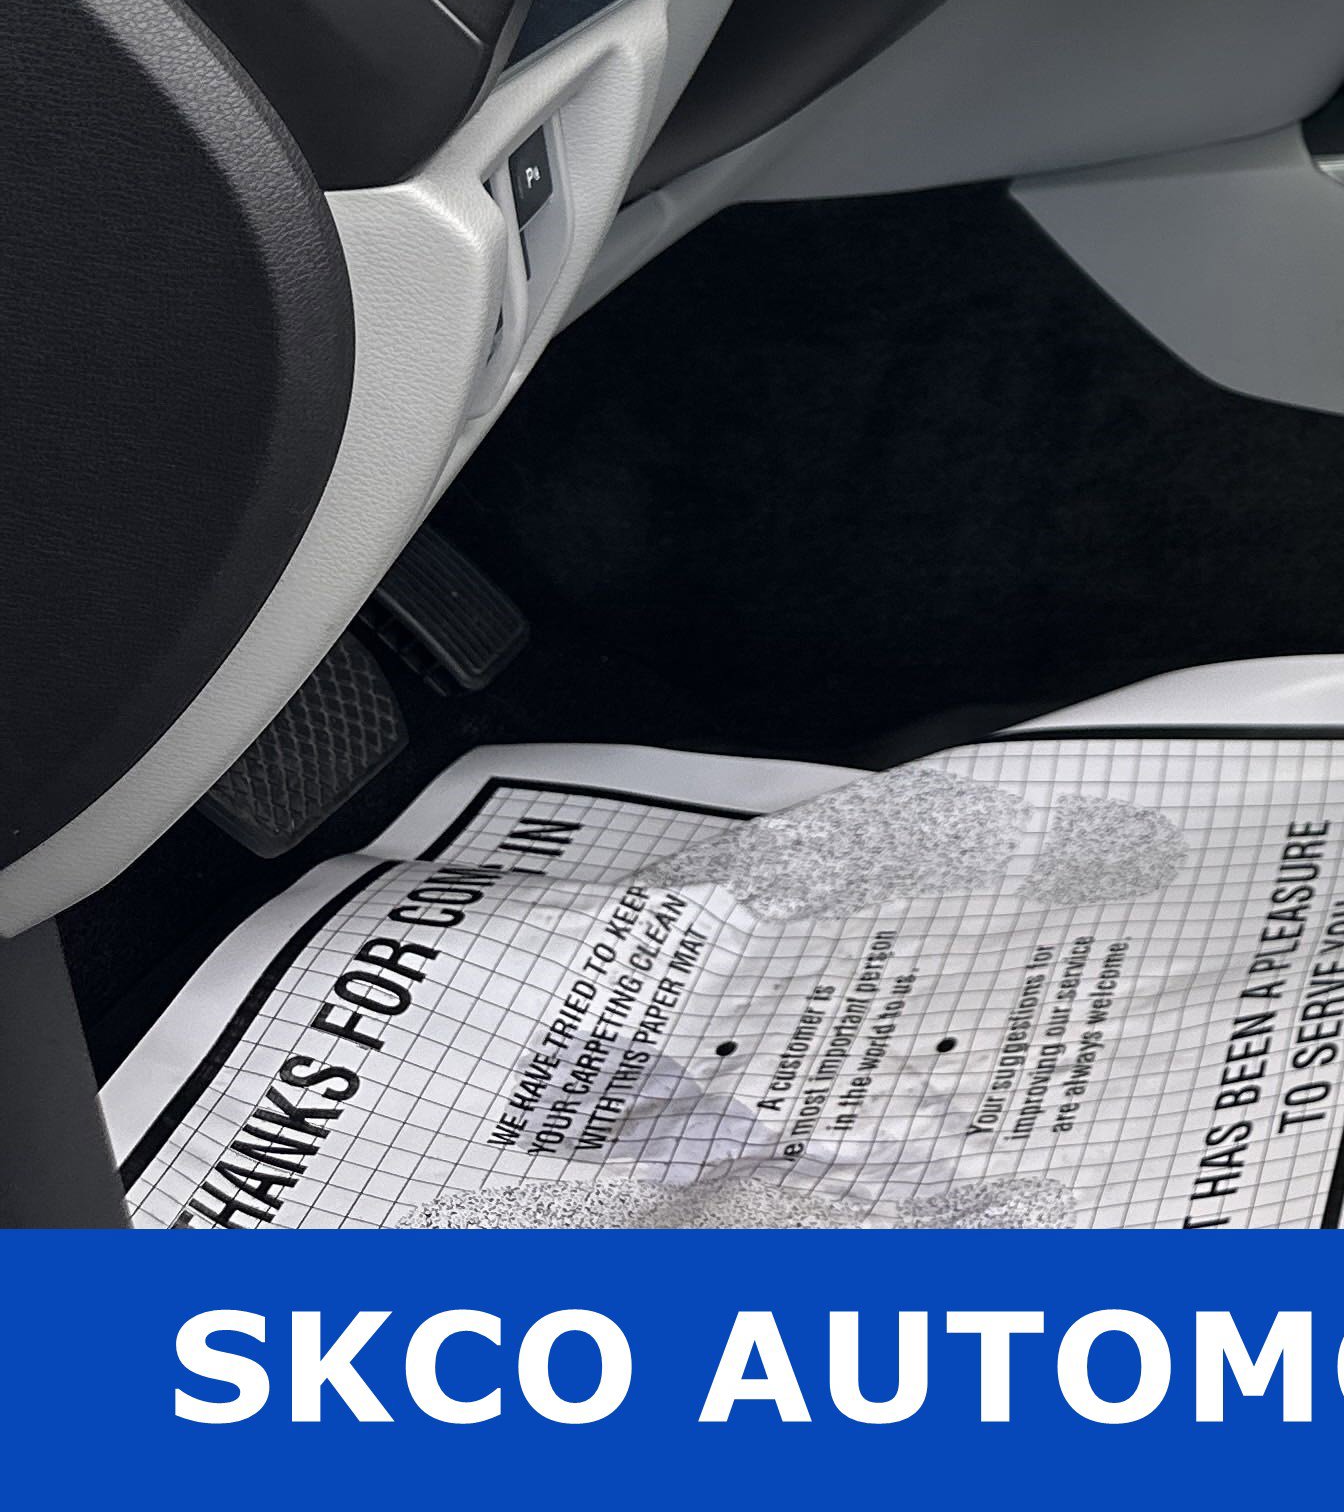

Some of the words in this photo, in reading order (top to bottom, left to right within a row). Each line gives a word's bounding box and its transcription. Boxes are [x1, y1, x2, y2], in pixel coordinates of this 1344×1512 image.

[1248, 819, 1331, 974] PLEASURE
[805, 984, 836, 1002] is
[856, 930, 898, 994] person
[1057, 935, 1096, 1000] service
[1240, 979, 1286, 999] A
[172, 1055, 360, 1229] HANKS
[310, 937, 442, 1051] FOR
[498, 817, 583, 856] IN
[487, 1112, 527, 1147] WE
[509, 1051, 561, 1112] HAVE
[542, 980, 597, 1049] TRIED
[583, 942, 616, 975] TO
[605, 885, 649, 940] KEEP
[528, 1098, 580, 1155] YOUR
[563, 974, 644, 1095] CARPETING
[630, 893, 687, 972] CLEAN
[575, 1096, 626, 1151] WITH
[606, 1049, 650, 1097] THIS
[632, 976, 685, 1045] PAPER
[668, 923, 708, 973] MAT
[808, 997, 870, 1083] important
[879, 999, 905, 1020] to
[966, 1096, 1007, 1137] Your
[992, 974, 1046, 1091] suggestions
[1026, 945, 1055, 970] for
[1045, 1006, 1072, 1038] our
[769, 1008, 826, 1091] customer
[857, 1022, 896, 1072] world
[1063, 1030, 1105, 1097] always
[1214, 1010, 1277, 1111] BEEN
[757, 1097, 785, 1111] A
[791, 1086, 830, 1136] most
[826, 1112, 858, 1132] in
[838, 1075, 872, 1108] the
[1003, 1042, 1067, 1141] improving
[1052, 1102, 1080, 1133] are
[1278, 1081, 1331, 1134] TO
[1190, 1120, 1252, 1201] HAS
